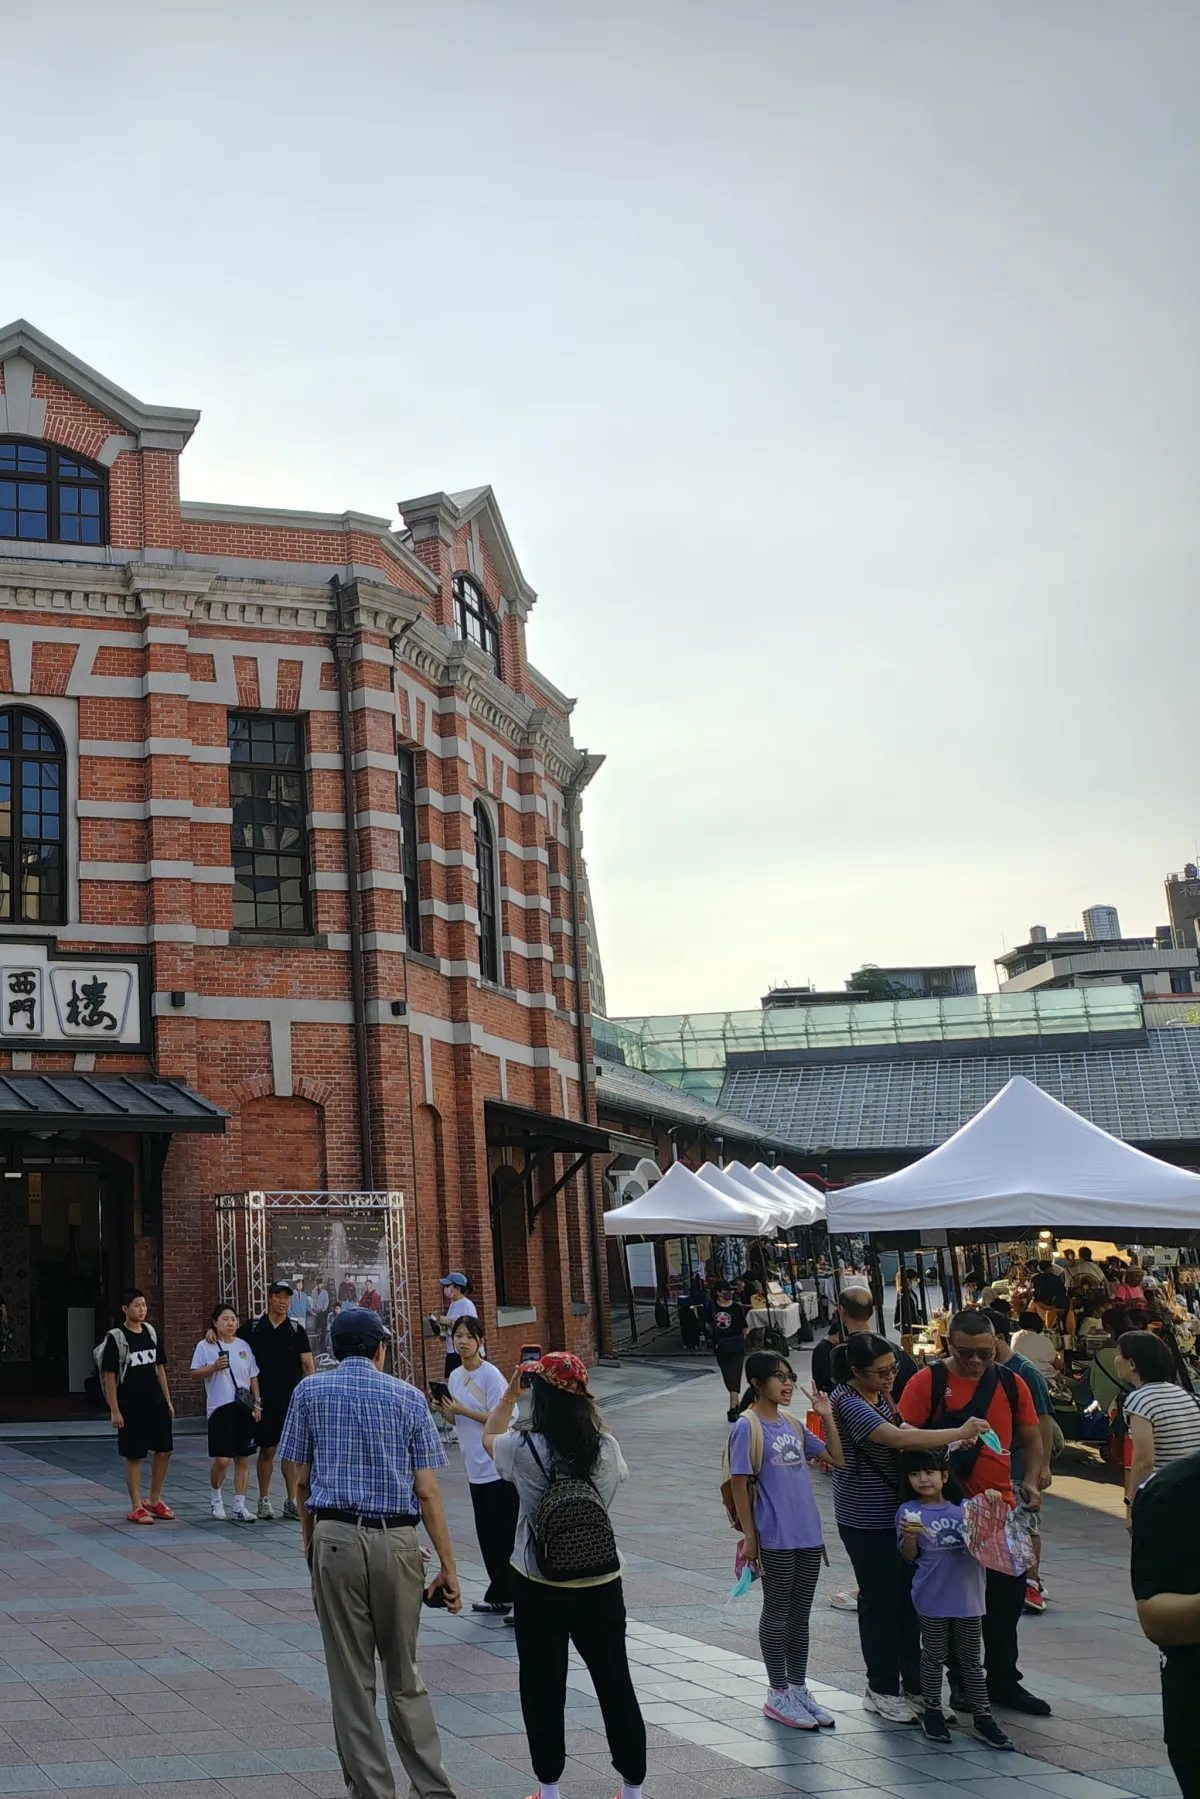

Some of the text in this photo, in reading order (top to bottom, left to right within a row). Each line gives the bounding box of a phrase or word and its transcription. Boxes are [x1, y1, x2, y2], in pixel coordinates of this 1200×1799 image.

[8, 971, 36, 1030] 西門
[66, 975, 118, 1030] 樓
[771, 1433, 802, 1453] ROOTS
